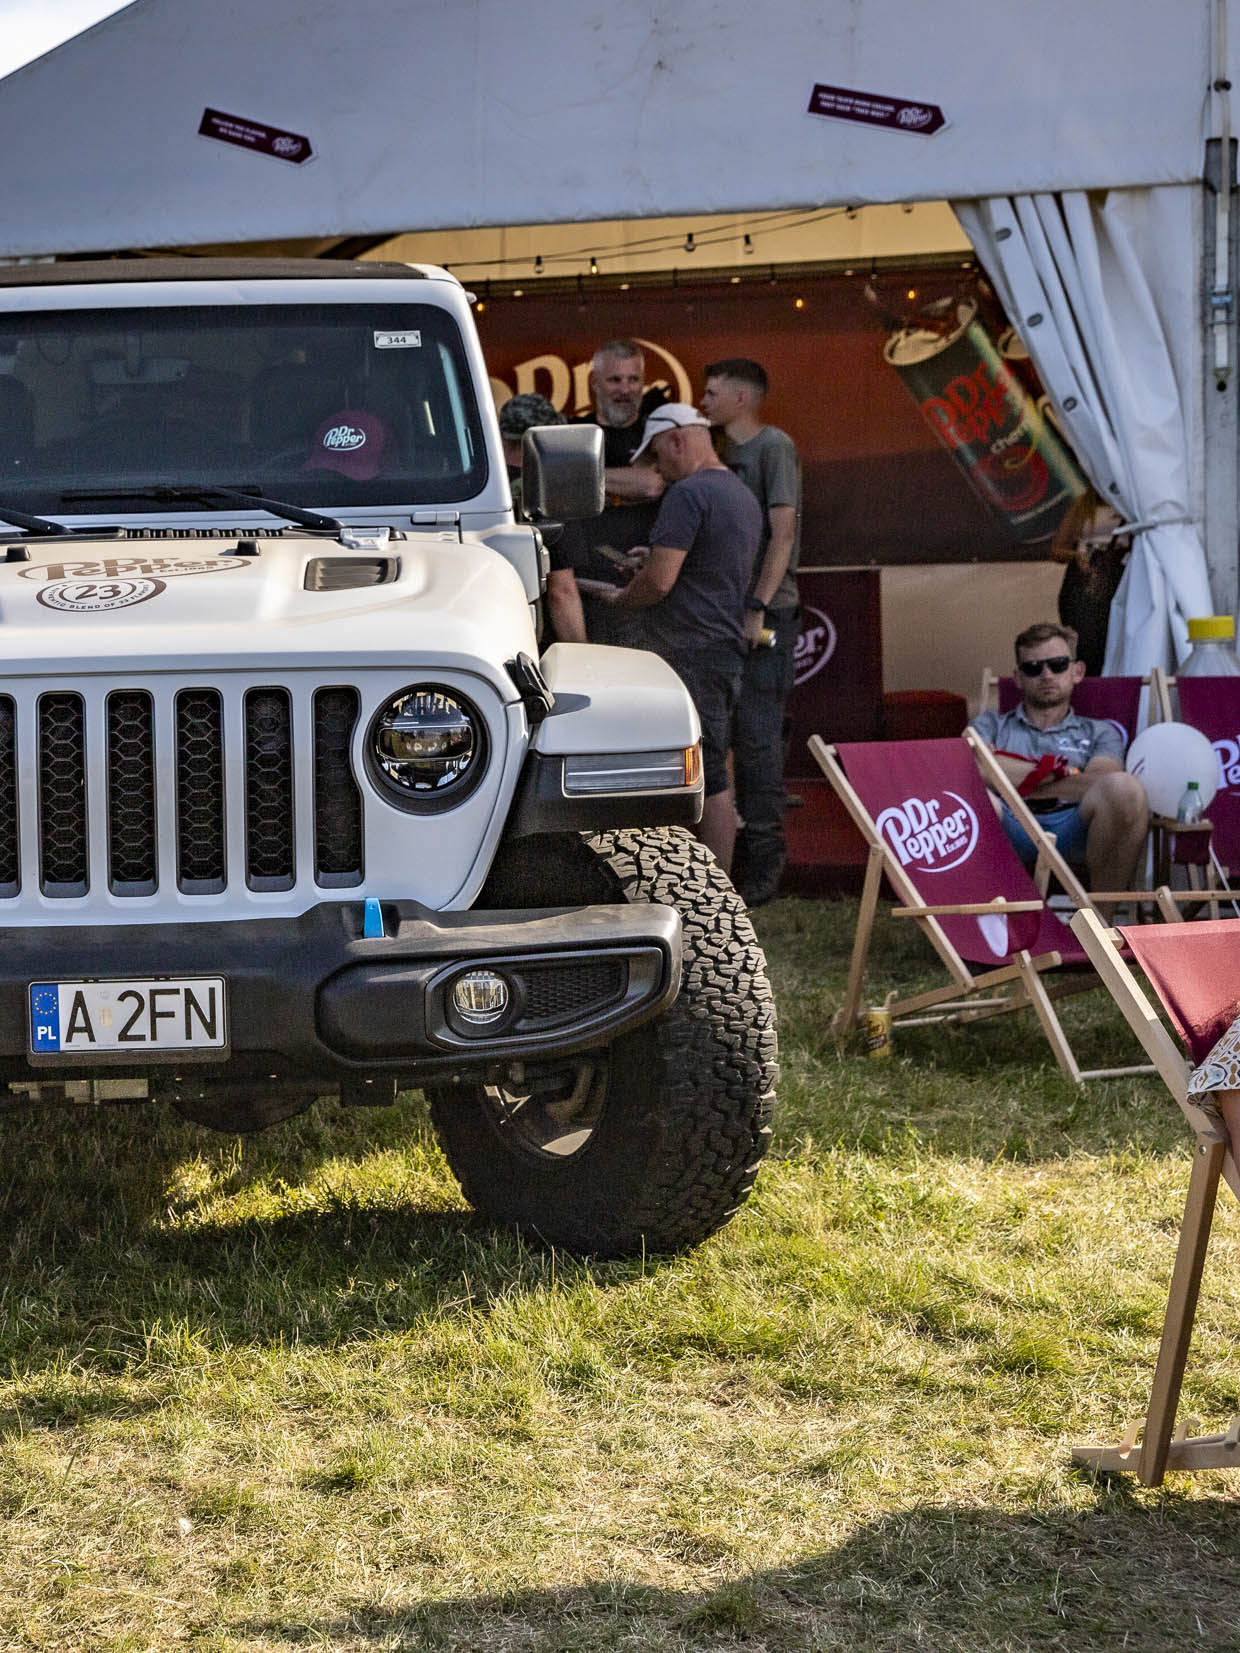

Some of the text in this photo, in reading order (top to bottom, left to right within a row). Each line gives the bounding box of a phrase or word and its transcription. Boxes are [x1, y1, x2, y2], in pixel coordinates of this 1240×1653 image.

[386, 336, 407, 345] 344
[323, 428, 363, 448] Pepper
[339, 425, 355, 436] Dr
[18, 561, 231, 580] Pepper
[75, 584, 122, 601] 23
[901, 797, 940, 835] Dr
[875, 806, 967, 867] Pepper
[64, 986, 218, 1043] A 2FN
[36, 1025, 57, 1041] PL
